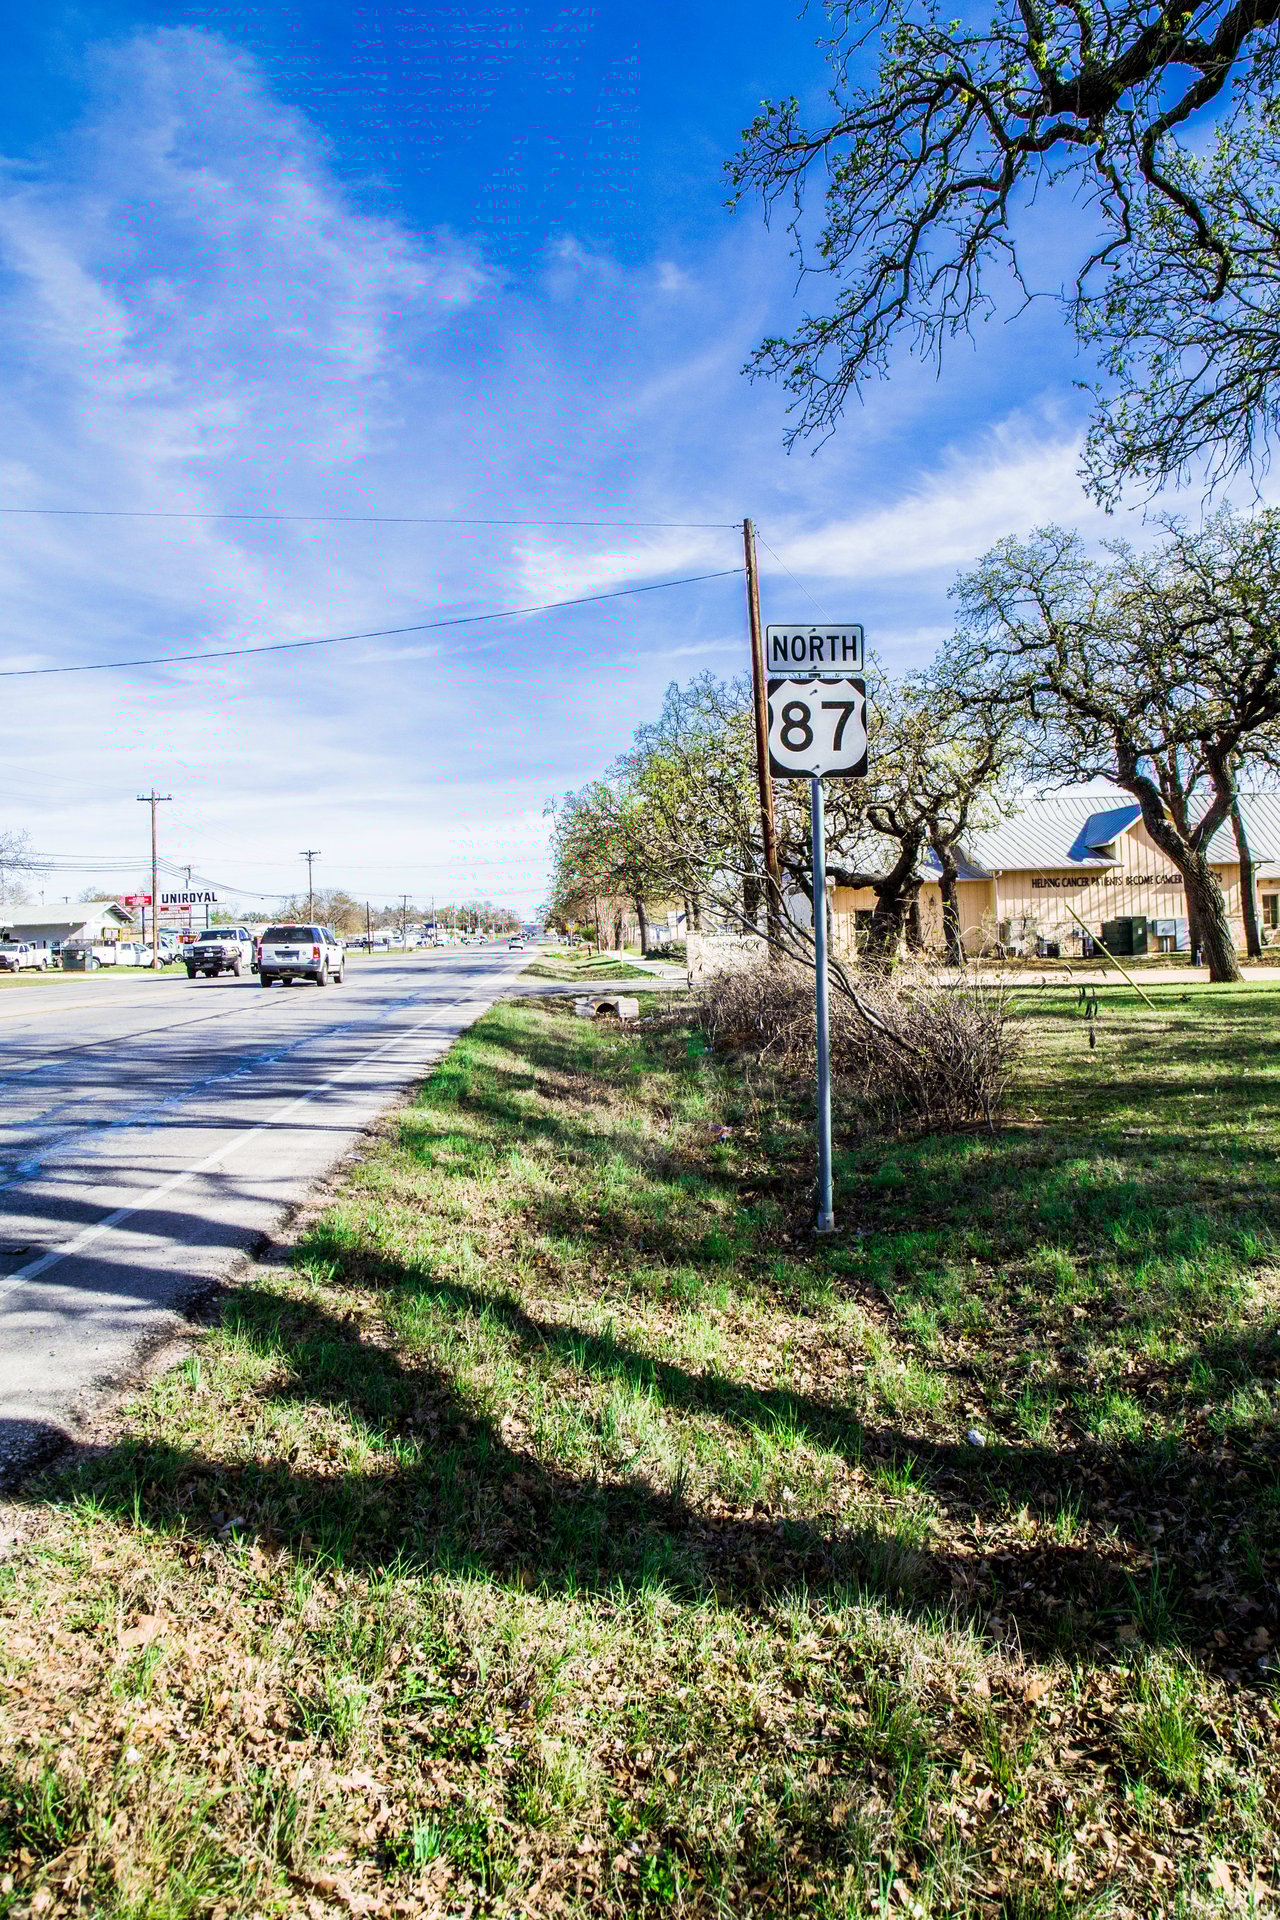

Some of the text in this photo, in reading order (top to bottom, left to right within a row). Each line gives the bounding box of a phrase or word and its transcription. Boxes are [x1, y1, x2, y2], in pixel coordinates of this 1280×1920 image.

[772, 635, 857, 662] NORTH
[780, 701, 855, 752] 87
[1031, 874, 1183, 889] HELPING CANCER PATIENTS BECOME CANCER
[161, 892, 218, 904] UNIROYAL
